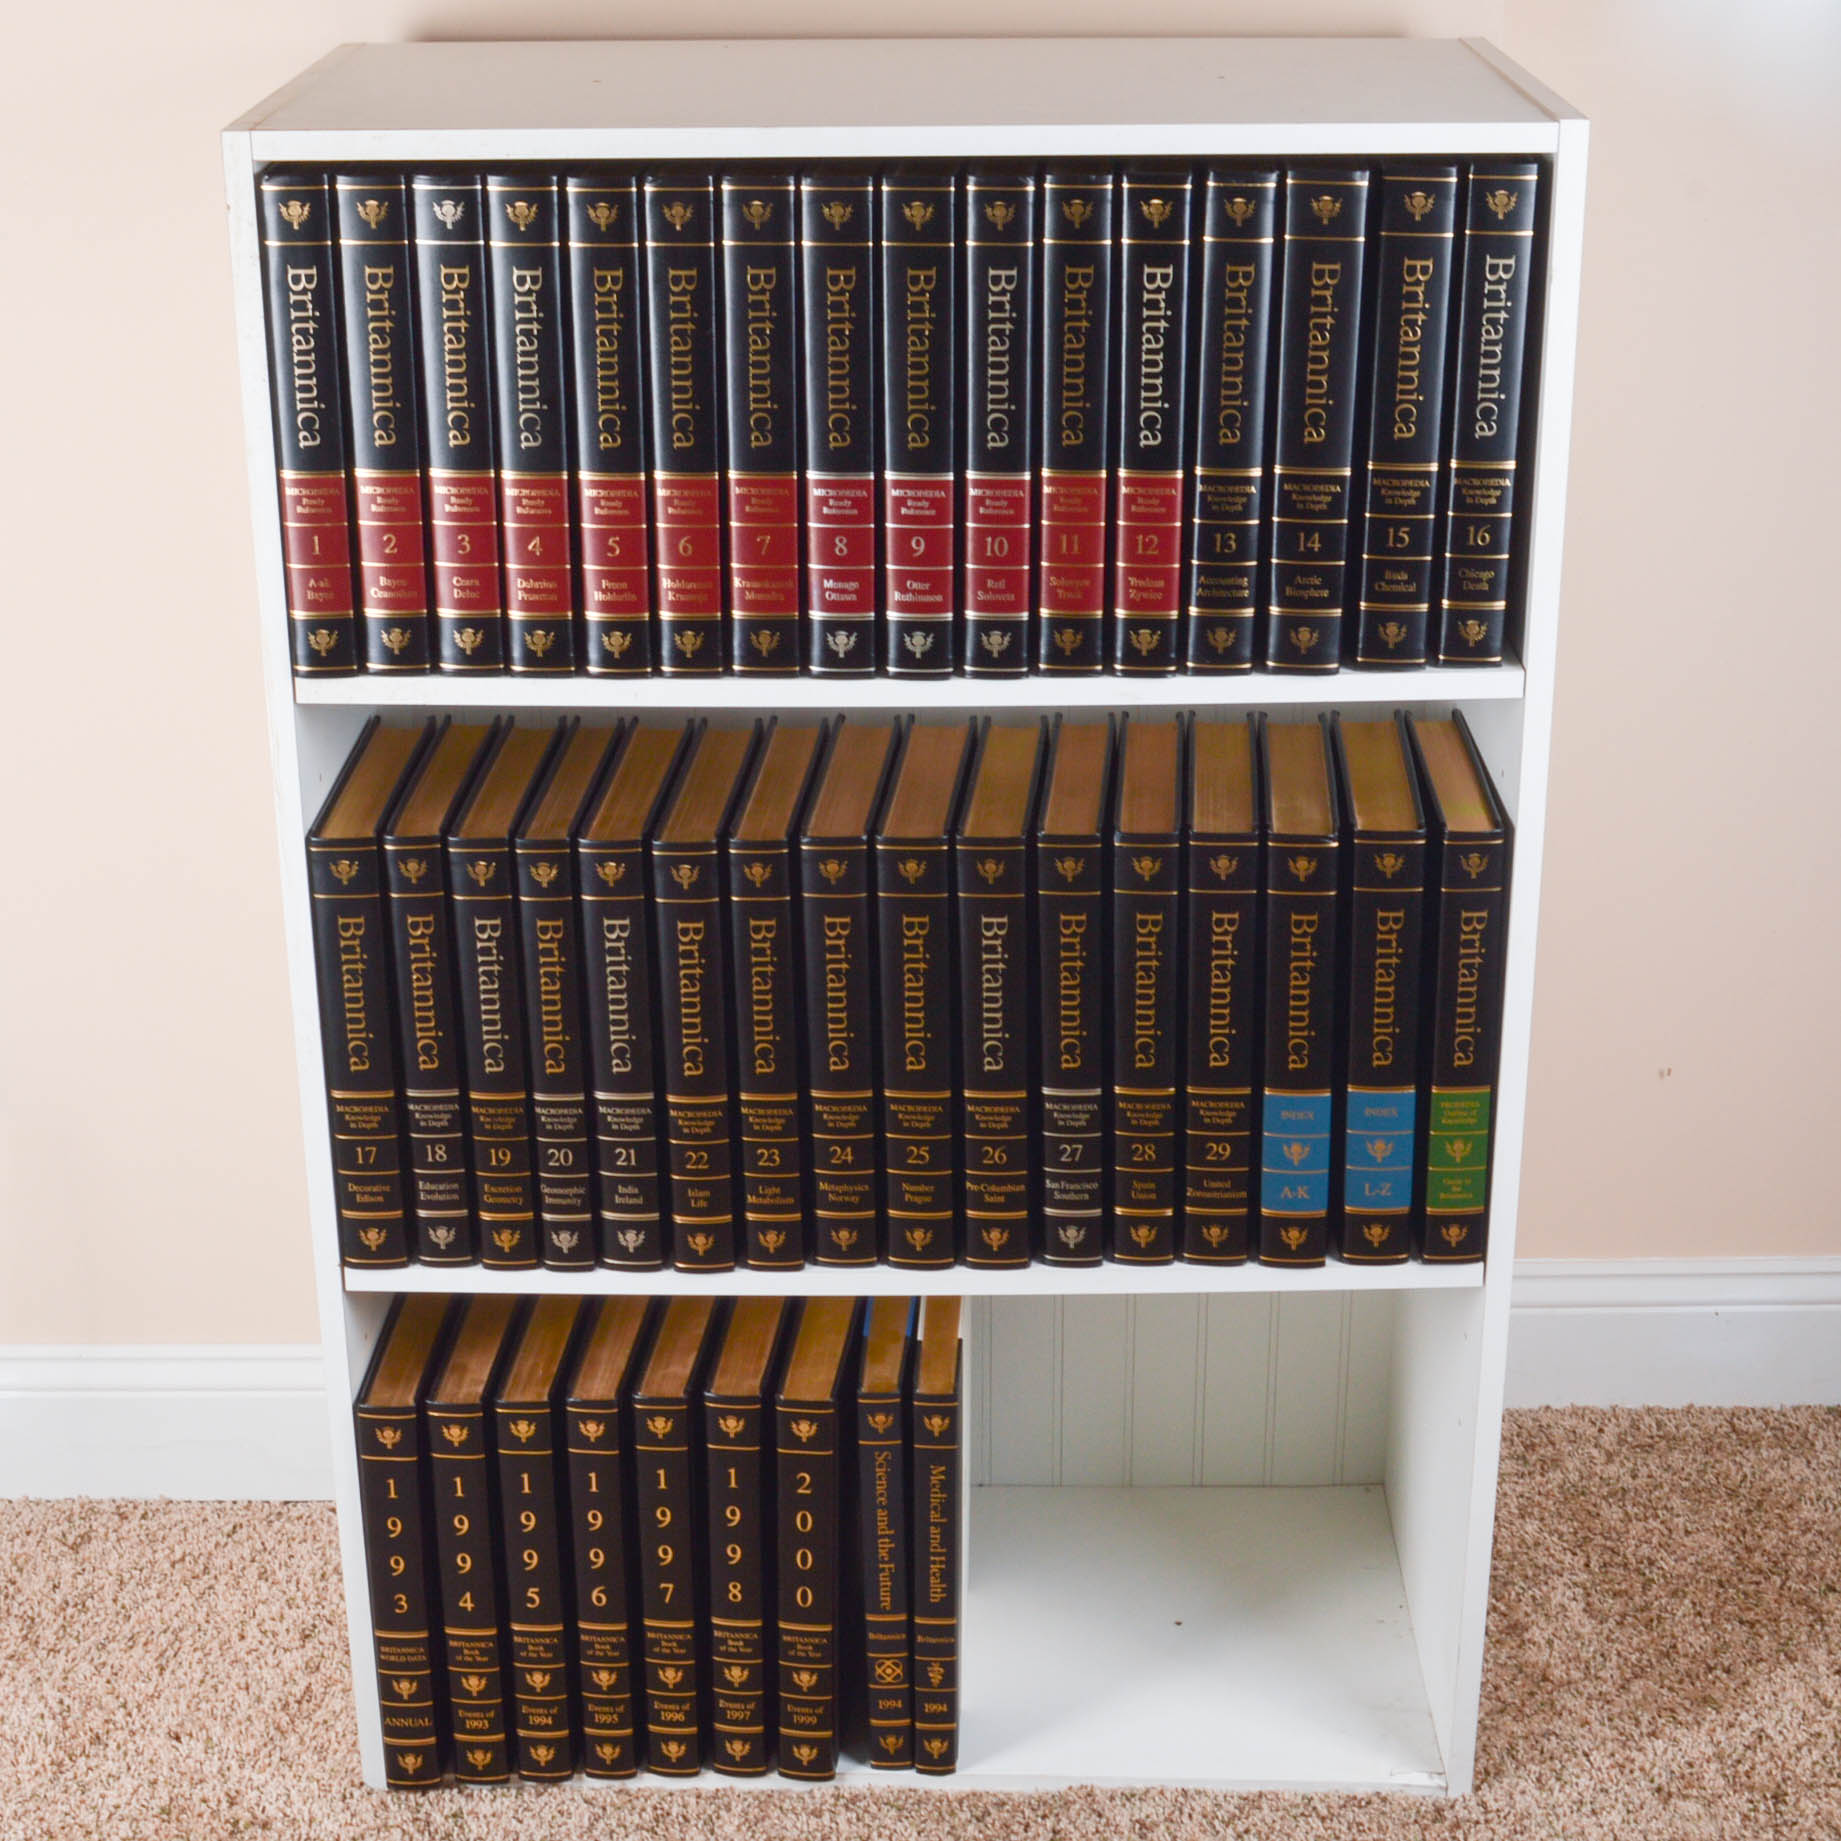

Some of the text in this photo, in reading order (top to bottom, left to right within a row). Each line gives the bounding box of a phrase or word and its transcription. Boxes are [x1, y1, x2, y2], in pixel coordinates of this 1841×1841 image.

[287, 264, 326, 449] Britannica
[364, 265, 402, 448] Britannica
[440, 264, 476, 448] Britannica
[747, 265, 779, 449] Britannica
[1061, 266, 1094, 447] Britannica
[1139, 264, 1174, 448] Britannica
[1219, 264, 1256, 445] Britannica
[1304, 262, 1341, 444] Britannica
[1394, 256, 1434, 440] Britannica
[1475, 254, 1516, 439] Britannica
[512, 266, 549, 451] Britannica
[593, 268, 627, 451] Britannica
[668, 268, 701, 450] Britannica
[827, 268, 857, 450] Britannica
[906, 267, 937, 450] Britannica
[987, 267, 1018, 450] Britannica
[312, 535, 320, 555] 1
[383, 534, 397, 554] 2
[457, 534, 471, 554] 3
[528, 536, 542, 556] 4
[756, 535, 770, 555] 7
[1060, 534, 1080, 554] 11
[1136, 534, 1159, 555] 12
[1214, 532, 1237, 553] 13
[1299, 532, 1321, 552] 14
[1387, 527, 1410, 548] 15
[1466, 524, 1491, 546] 16
[607, 536, 620, 557] 5
[679, 536, 692, 557] 6
[834, 536, 848, 557] 8
[911, 536, 925, 557] 9
[985, 536, 1008, 557] 10
[338, 916, 373, 1072] Britannica
[407, 914, 443, 1071] Britannica
[475, 917, 509, 1075] Britannica
[536, 918, 571, 1074] Britannica
[603, 917, 637, 1075] Britannica
[677, 920, 709, 1076] Britannica
[750, 918, 781, 1074] Britannica
[824, 916, 854, 1072] Britannica
[903, 915, 932, 1072] Britannica
[981, 915, 1009, 1072] Britannica
[1060, 914, 1088, 1069] Britannica
[1135, 913, 1163, 1069] Britannica
[1209, 912, 1240, 1068] Britannica
[1288, 913, 1319, 1070] Britannica
[1373, 910, 1405, 1067] Britannica
[1454, 911, 1489, 1067] Britannica
[356, 1147, 377, 1164] 17
[426, 1144, 447, 1162] 18
[490, 1148, 511, 1166] 19
[548, 1149, 573, 1167] 20
[615, 1148, 636, 1166] 21
[685, 1151, 709, 1169] 22
[757, 1148, 780, 1167] 23
[830, 1146, 853, 1164] 24
[906, 1145, 929, 1164] 25
[982, 1146, 1007, 1165] 26
[1059, 1144, 1083, 1162] 27
[1131, 1144, 1156, 1161] 28
[1205, 1142, 1231, 1160] 29
[1281, 1185, 1310, 1199] A-K
[1365, 1183, 1392, 1196] L-Z
[874, 1451, 896, 1611] Science and the Future
[929, 1465, 948, 1603] Medical and Health
[384, 1716, 432, 1728] ANNUAL
[661, 1711, 685, 1722] 1996
[726, 1710, 750, 1720] 1997
[793, 1715, 817, 1725] 1999
